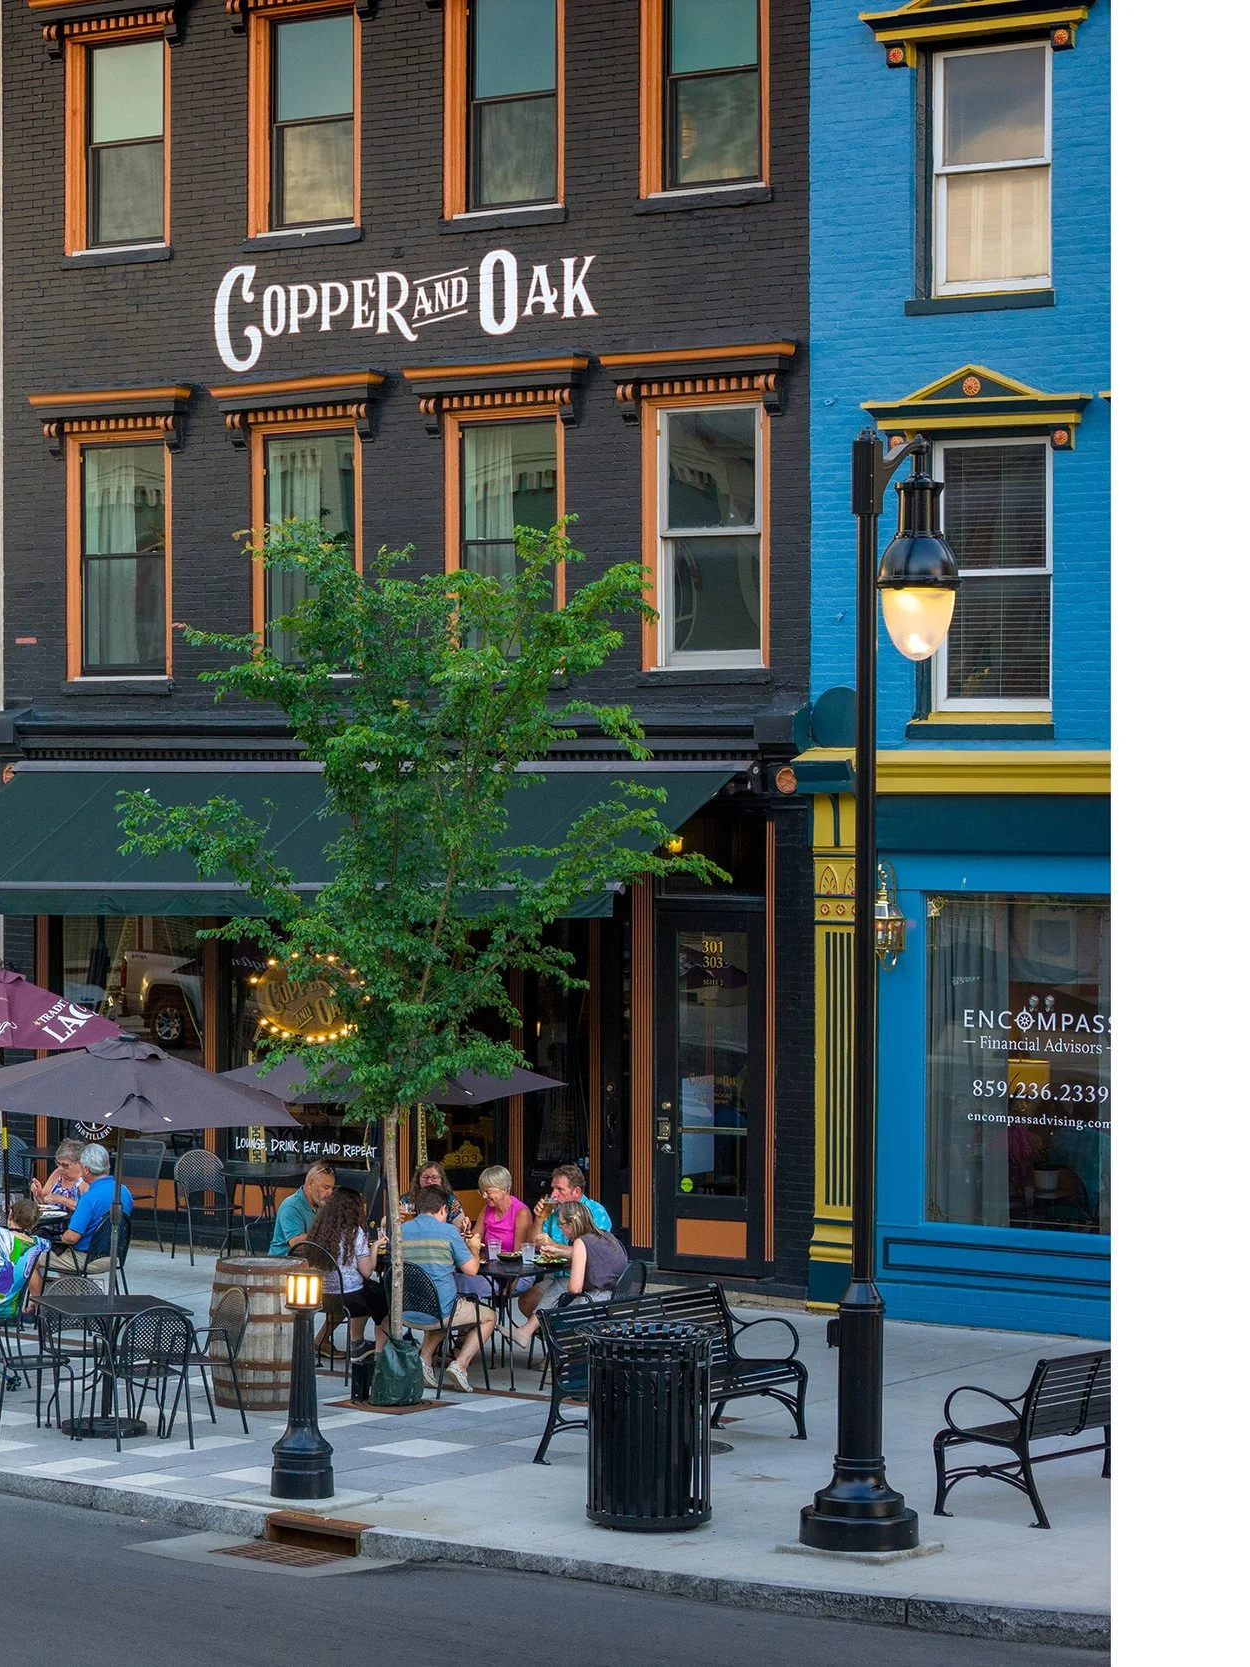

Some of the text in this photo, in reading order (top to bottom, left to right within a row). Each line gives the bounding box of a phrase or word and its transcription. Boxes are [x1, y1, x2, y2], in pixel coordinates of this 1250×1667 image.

[213, 249, 598, 372] COPPER AND OAK
[702, 940, 724, 953] 301
[703, 956, 723, 969] 303
[295, 997, 342, 1026] AND OA
[963, 1007, 1111, 1034] ENCOMPAS
[979, 1036, 1103, 1054] Financial Advisors
[972, 1079, 1109, 1103] 859.236.2339
[967, 1112, 1111, 1130] encompassadvising.com
[75, 1122, 113, 1140] DISTILLERY
[303, 1141, 321, 1155] EAT
[322, 1142, 341, 1155] AND
[343, 1144, 378, 1158] REPEAT
[453, 1154, 479, 1164] 303
